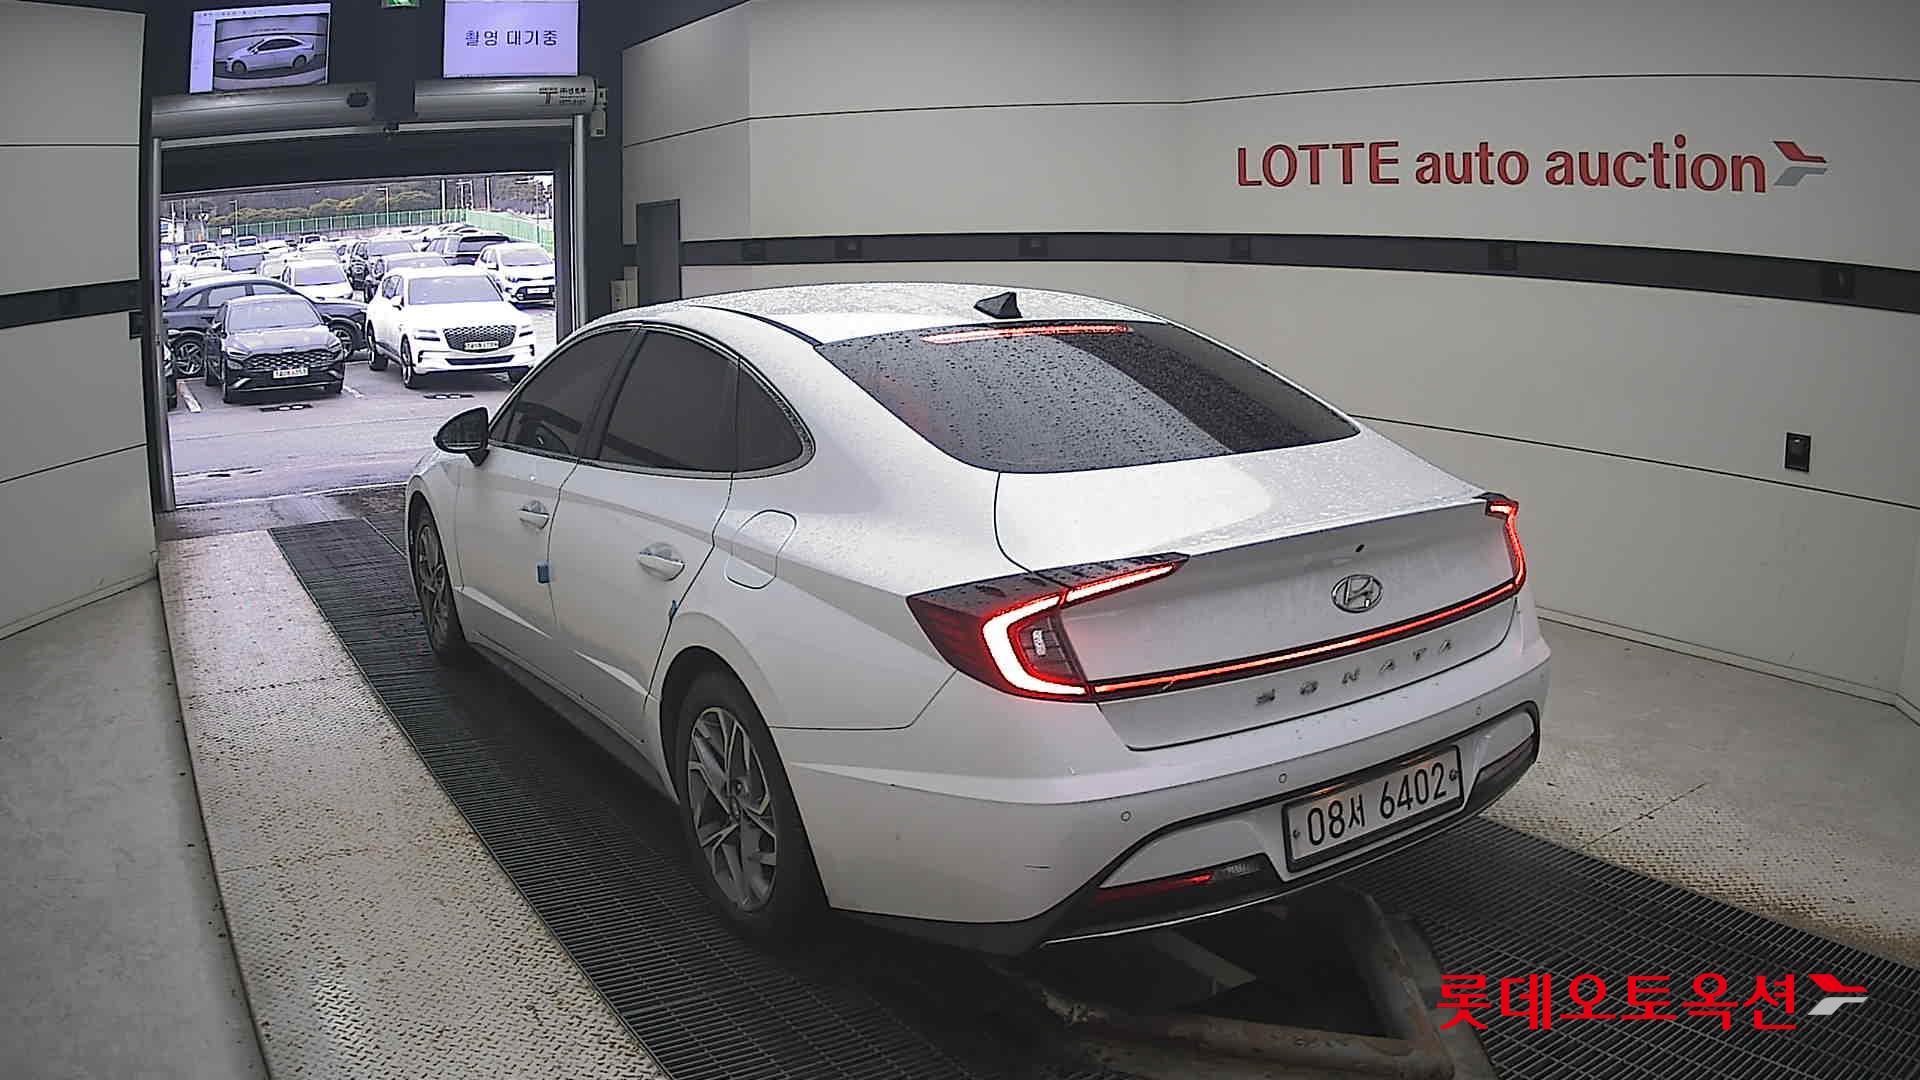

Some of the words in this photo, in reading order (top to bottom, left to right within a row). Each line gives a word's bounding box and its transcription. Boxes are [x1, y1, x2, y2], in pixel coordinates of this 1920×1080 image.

[506, 29, 558, 47] 대기중
[1237, 140, 1400, 188] LOTTE
[1414, 141, 1529, 186] auto
[1545, 133, 1767, 193] auction
[1255, 638, 1452, 706] SONATA
[1307, 793, 1366, 847] 08서
[1380, 762, 1448, 820] 6402
